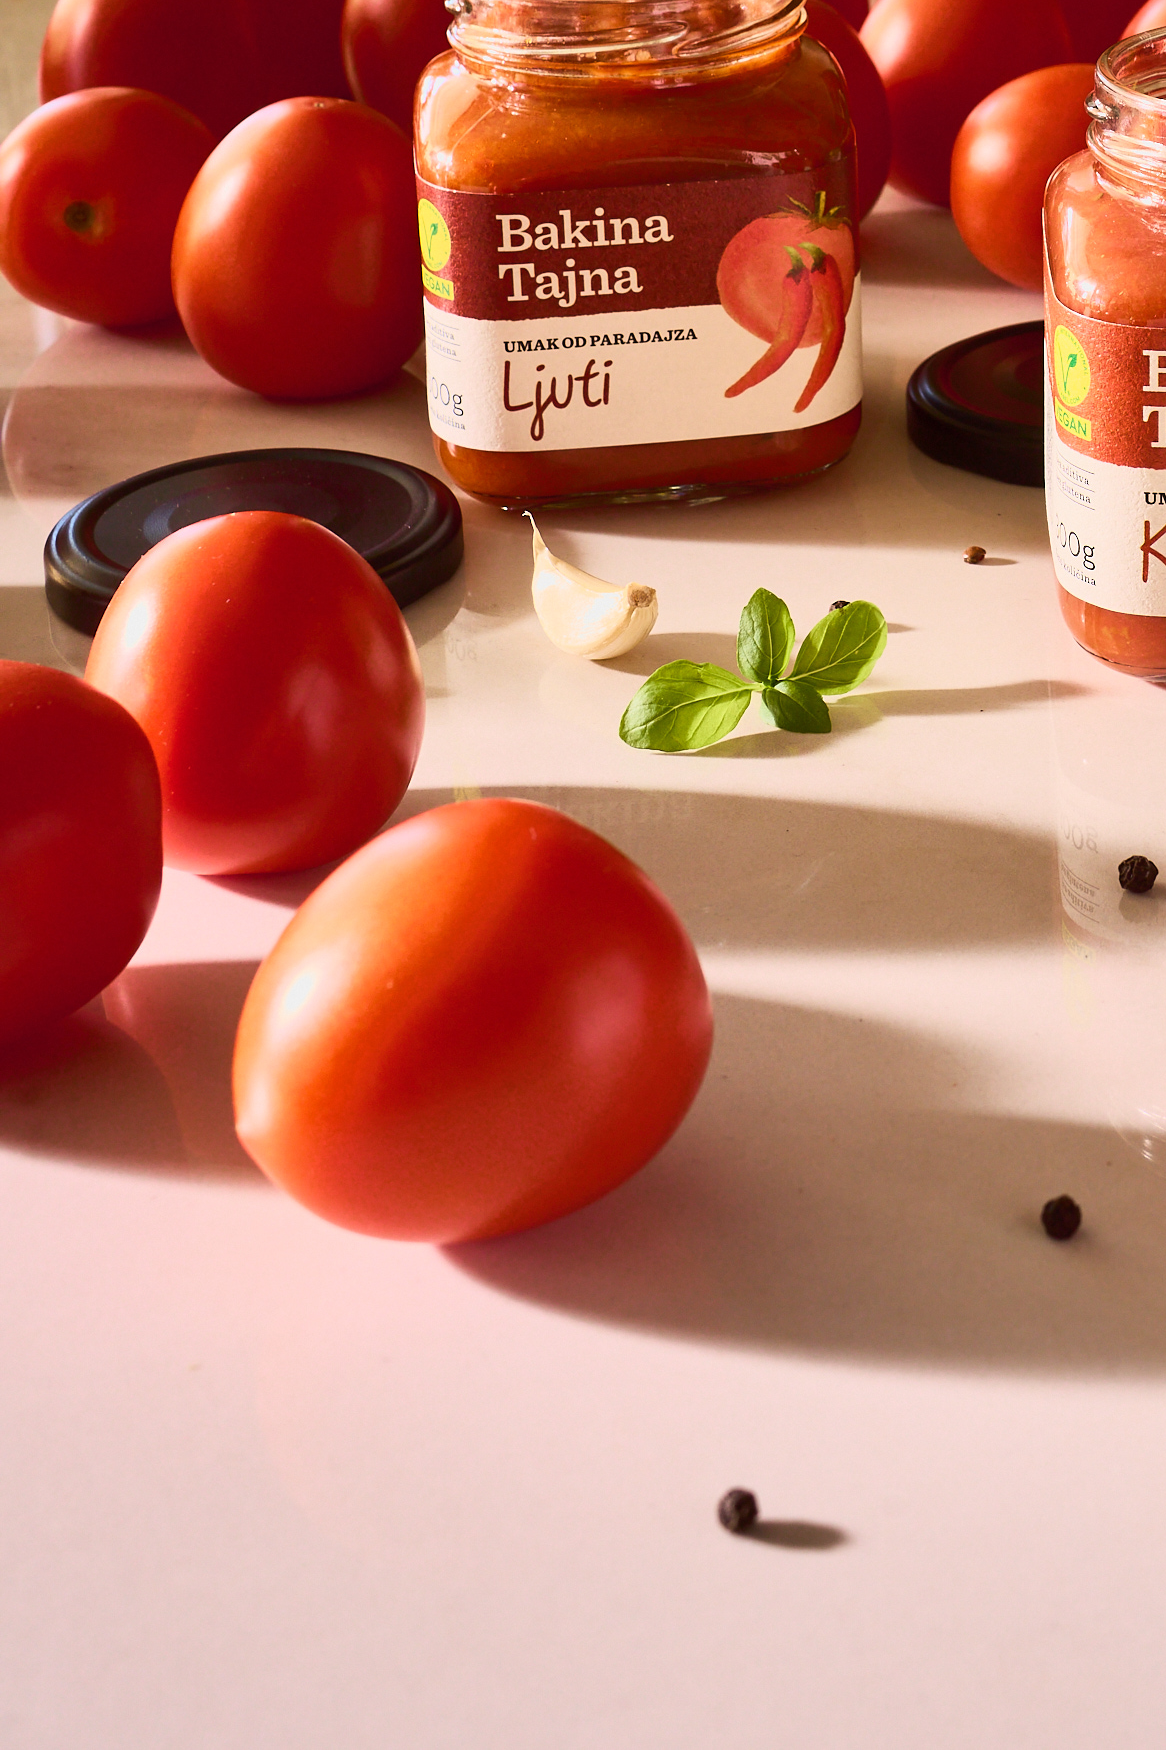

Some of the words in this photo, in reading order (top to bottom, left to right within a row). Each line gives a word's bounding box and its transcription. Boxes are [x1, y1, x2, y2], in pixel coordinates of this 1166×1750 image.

[496, 207, 674, 252] Bakina
[423, 273, 450, 297] EGAN
[498, 259, 643, 307] Tajna
[503, 338, 559, 353] UMAK
[562, 335, 587, 349] OD
[589, 328, 698, 347] PARADAJZA
[503, 359, 613, 441] Ljuti
